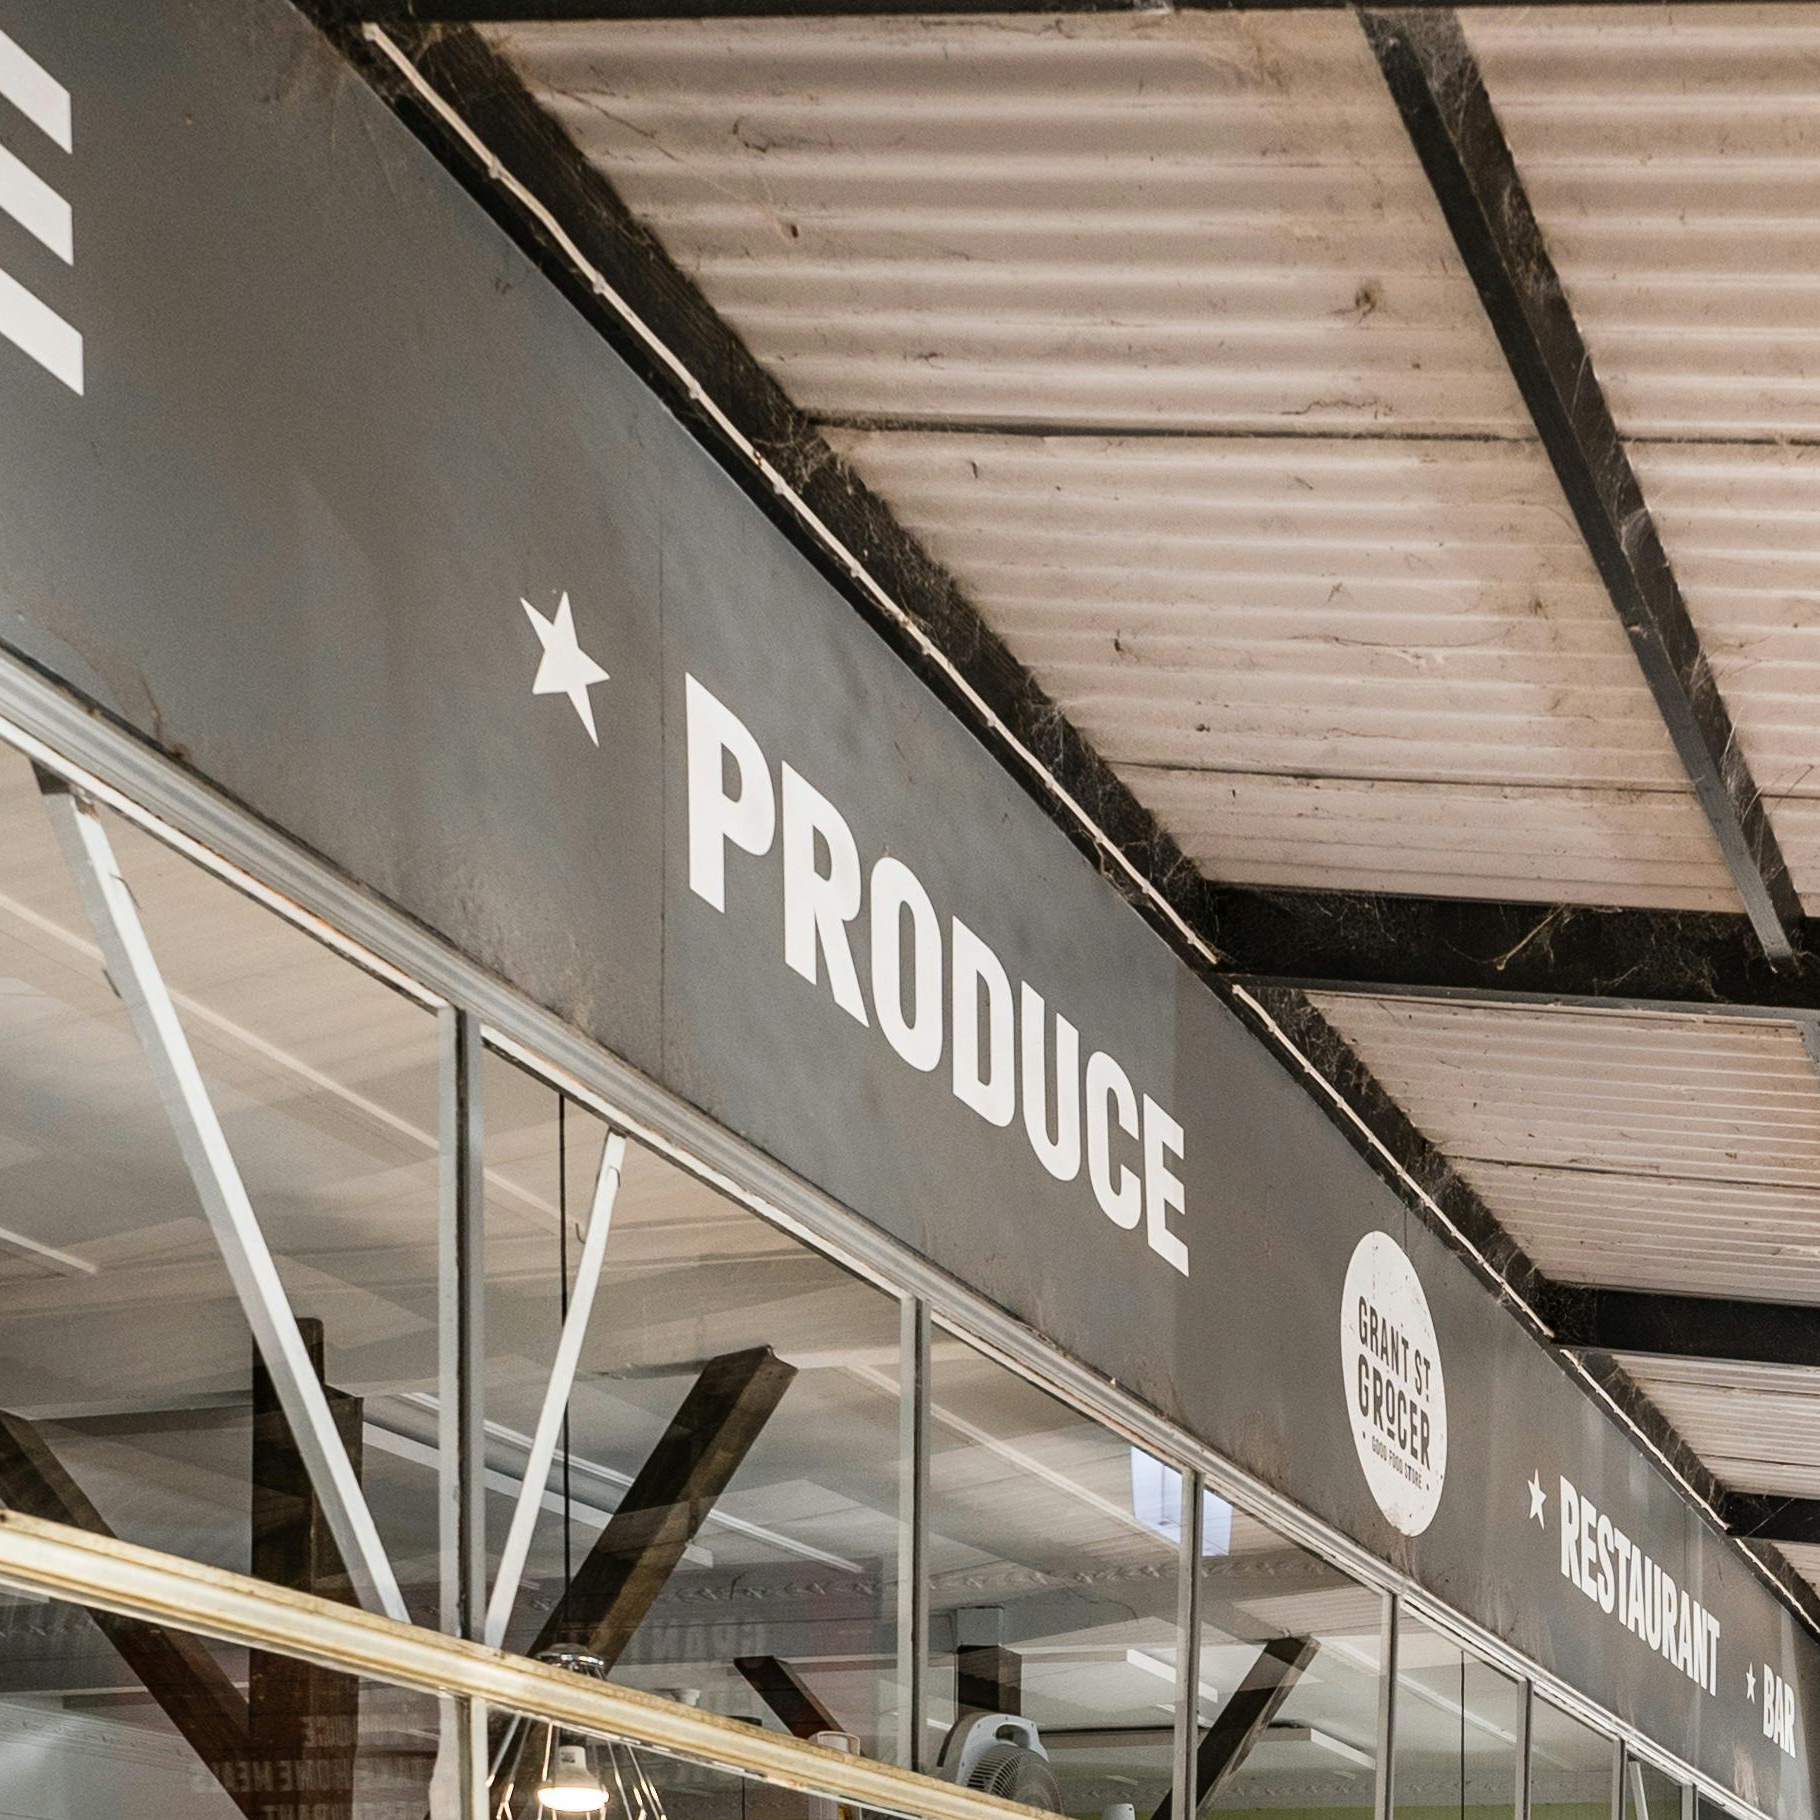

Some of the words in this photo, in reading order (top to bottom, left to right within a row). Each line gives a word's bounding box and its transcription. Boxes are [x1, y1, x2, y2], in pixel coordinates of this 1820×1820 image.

[685, 673, 1190, 1278] PRODUCE
[1358, 1295, 1409, 1384] GRANT
[1413, 1347, 1431, 1402] ST
[1358, 1353, 1431, 1471] GROCER
[1371, 1435, 1387, 1462] GOOD
[1389, 1449, 1403, 1474] FOOD
[1405, 1462, 1422, 1490] STORE
[1559, 1473, 1721, 1698] RESTAURANT
[1762, 1662, 1797, 1759] BAR
